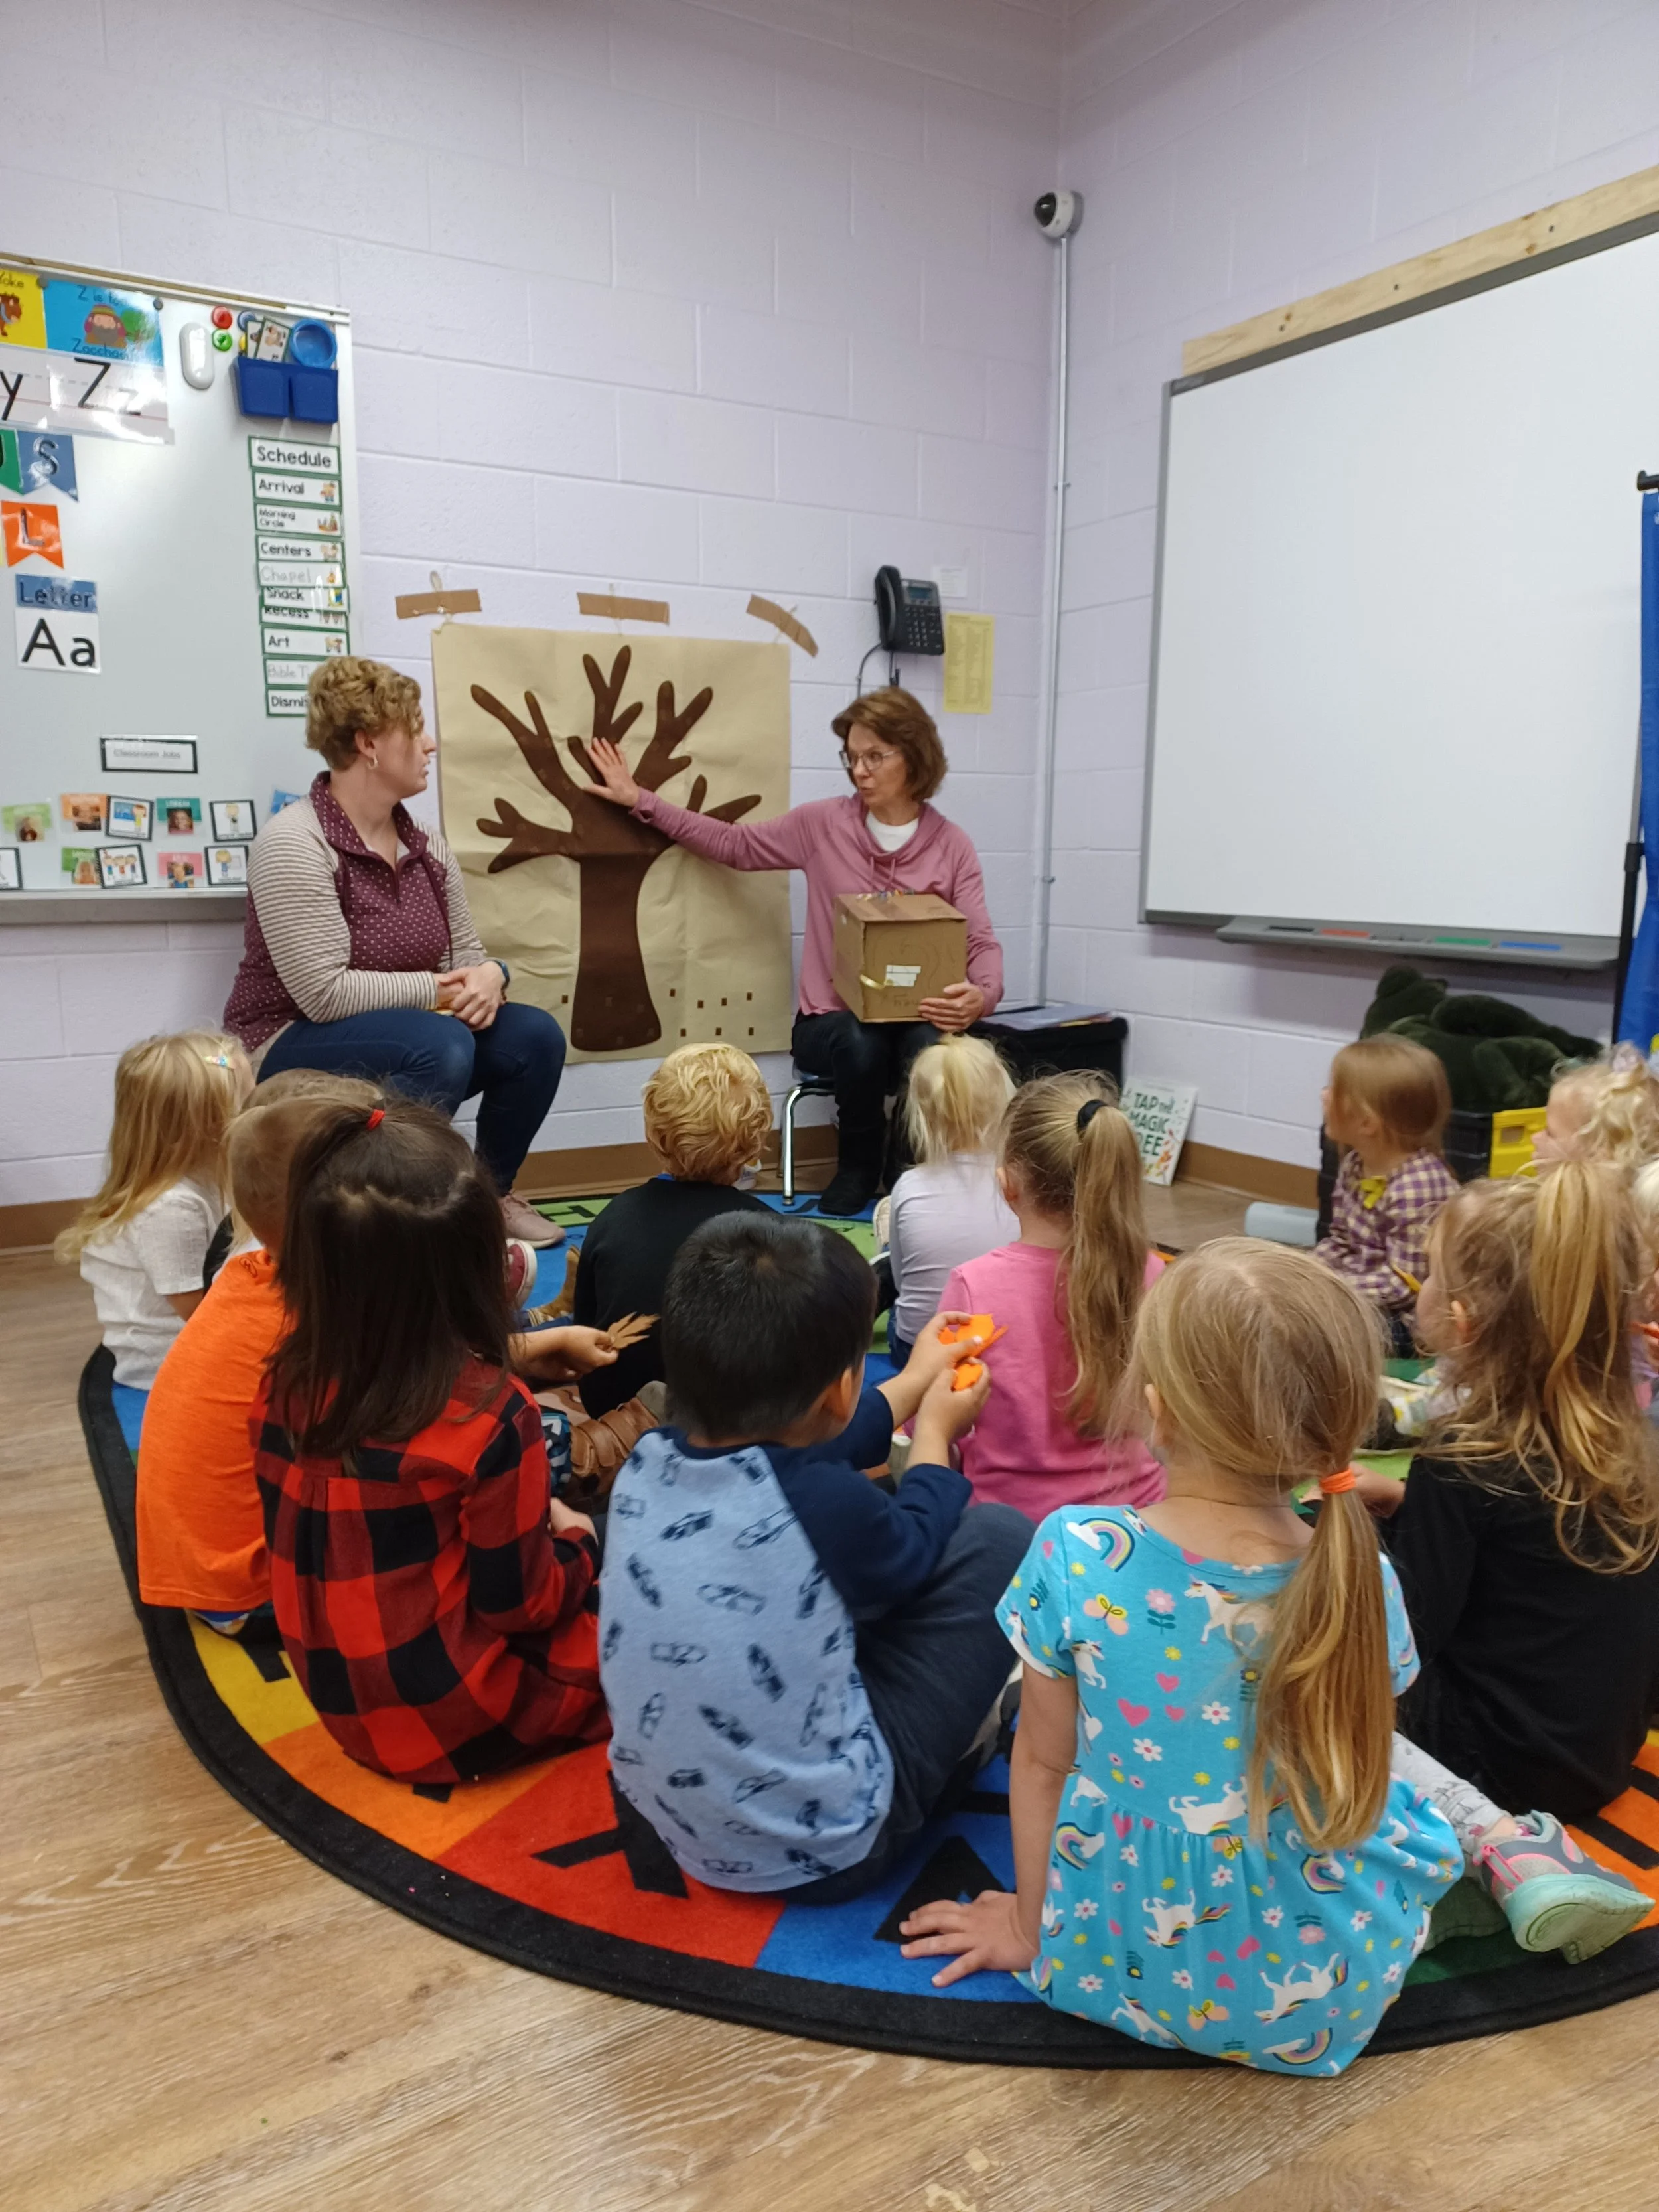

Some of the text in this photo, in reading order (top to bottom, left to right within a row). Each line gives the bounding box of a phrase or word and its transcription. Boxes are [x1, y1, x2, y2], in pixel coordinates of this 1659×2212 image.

[77, 285, 89, 301] Z
[257, 445, 332, 468] Schedule
[259, 478, 305, 494] Arrival
[259, 508, 296, 521] Morning
[19, 506, 45, 546] L
[259, 518, 285, 528] Circle
[261, 542, 312, 557] Centers
[260, 565, 311, 584] Chapel
[19, 581, 92, 609] Letter
[267, 587, 305, 601] Snack
[21, 617, 96, 668] Aa
[268, 634, 290, 648] Art
[267, 663, 297, 678] Bible
[113, 748, 182, 759] Classroom Jobs
[1133, 1092, 1159, 1111] TAP
